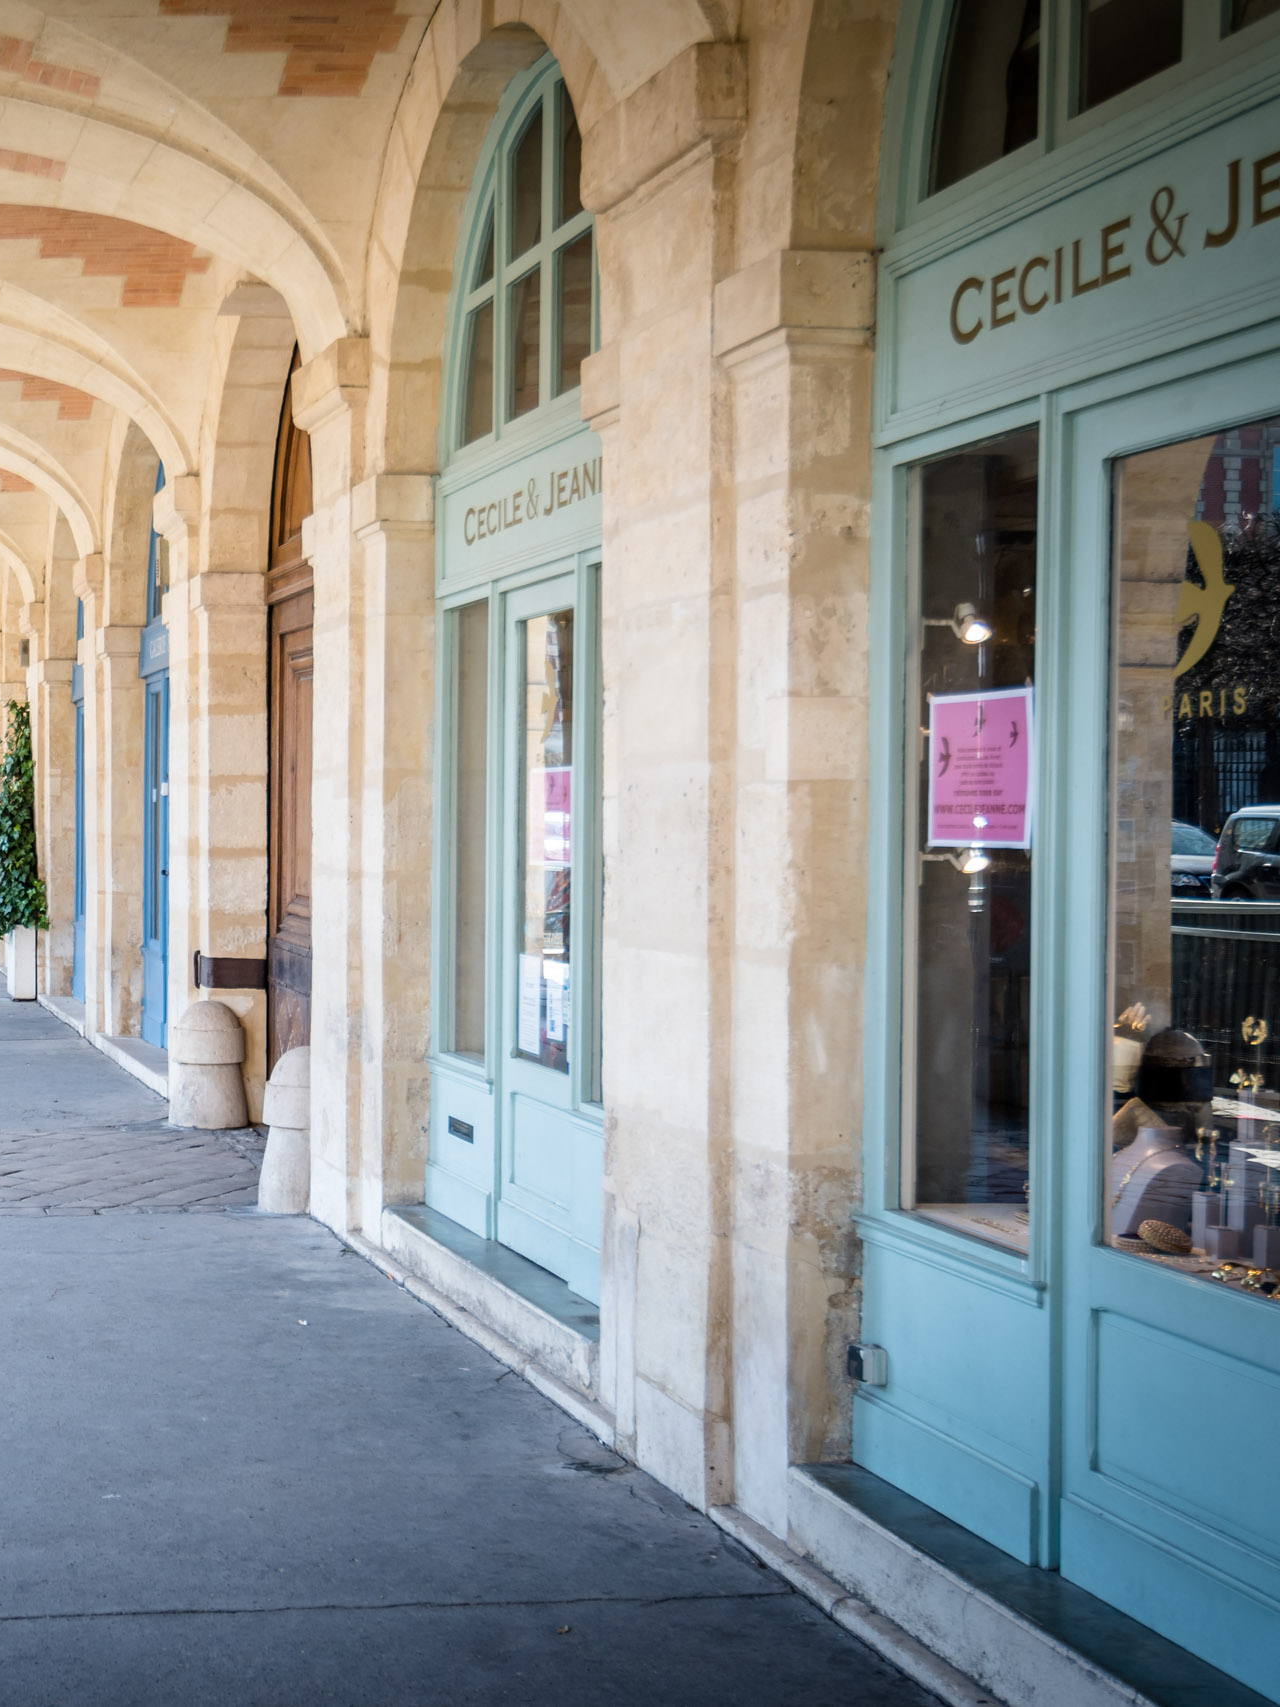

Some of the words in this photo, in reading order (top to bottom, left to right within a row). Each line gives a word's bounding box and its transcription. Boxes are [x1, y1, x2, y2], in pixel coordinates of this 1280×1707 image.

[950, 217, 1132, 345] CECILE
[1145, 186, 1190, 266] &
[464, 491, 523, 546] CECILE
[526, 478, 540, 520] &
[1160, 687, 1247, 720] PARIS
